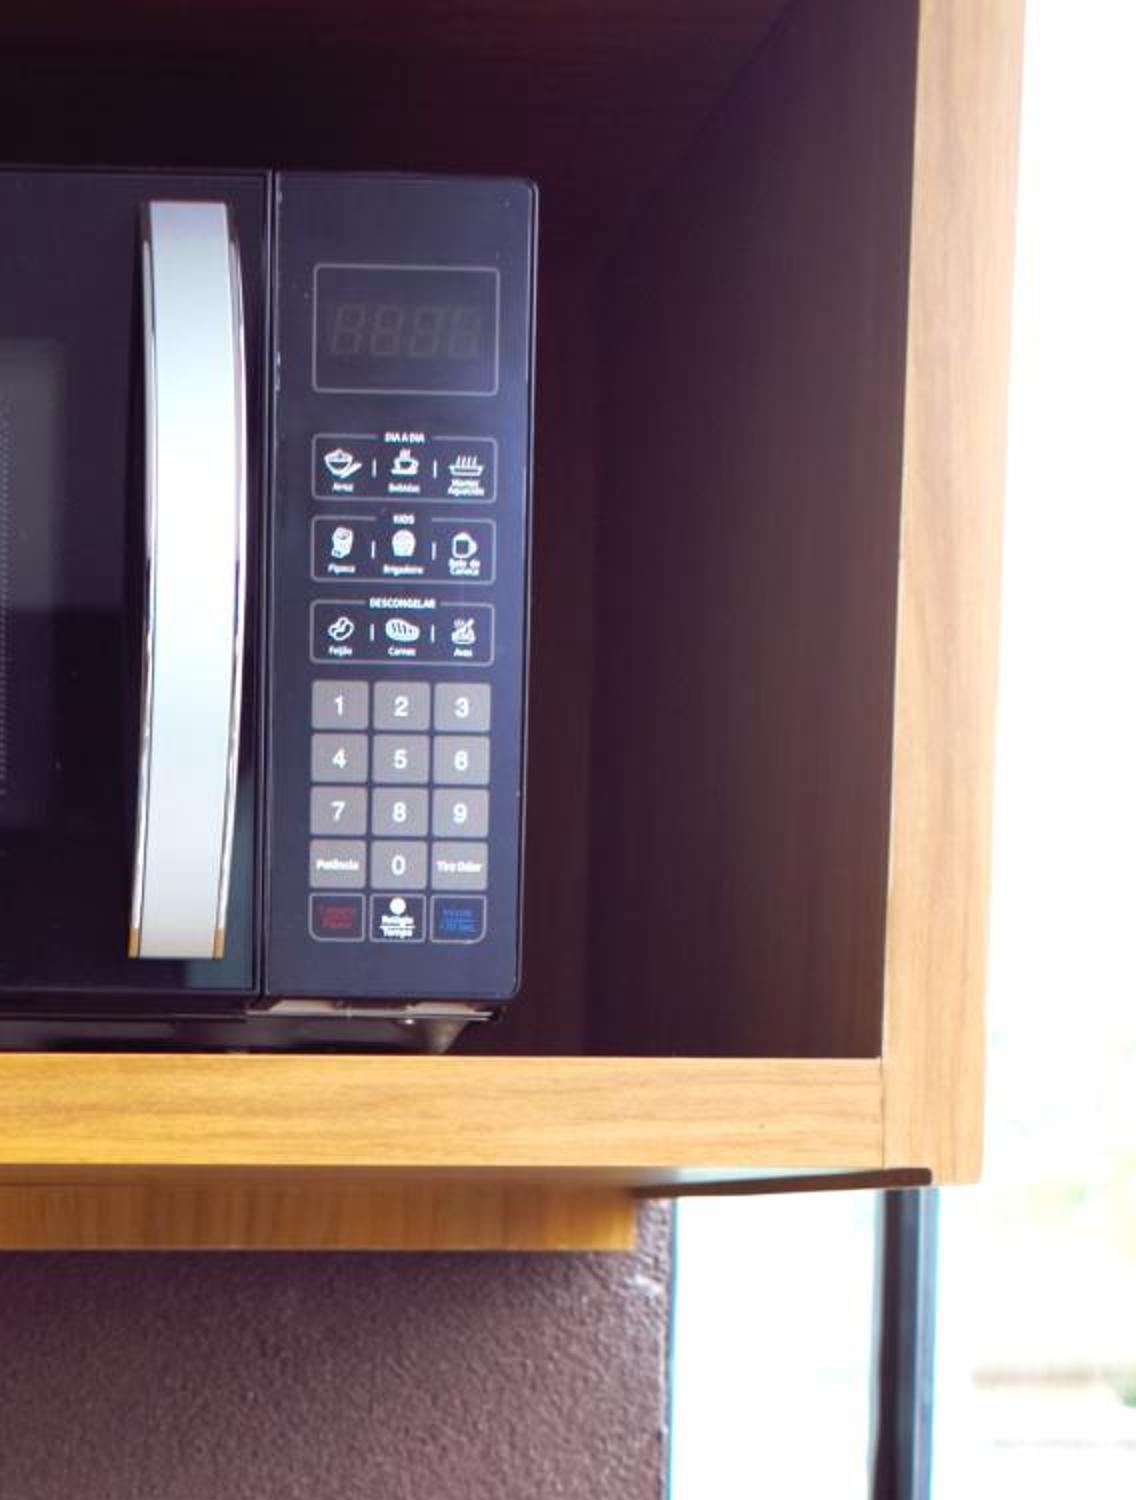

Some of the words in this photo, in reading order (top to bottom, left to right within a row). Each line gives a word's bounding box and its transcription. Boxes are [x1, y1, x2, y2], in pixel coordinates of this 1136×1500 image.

[369, 597, 436, 608] DESCONGELAR
[334, 695, 344, 716] 1
[394, 696, 409, 717] 2
[454, 697, 470, 718] 3
[332, 748, 347, 769] 4
[393, 748, 408, 769] 5
[453, 750, 468, 771] 6
[330, 801, 345, 821] 7
[392, 801, 407, 822] 8
[452, 802, 468, 824] 9
[391, 855, 406, 876] 0
